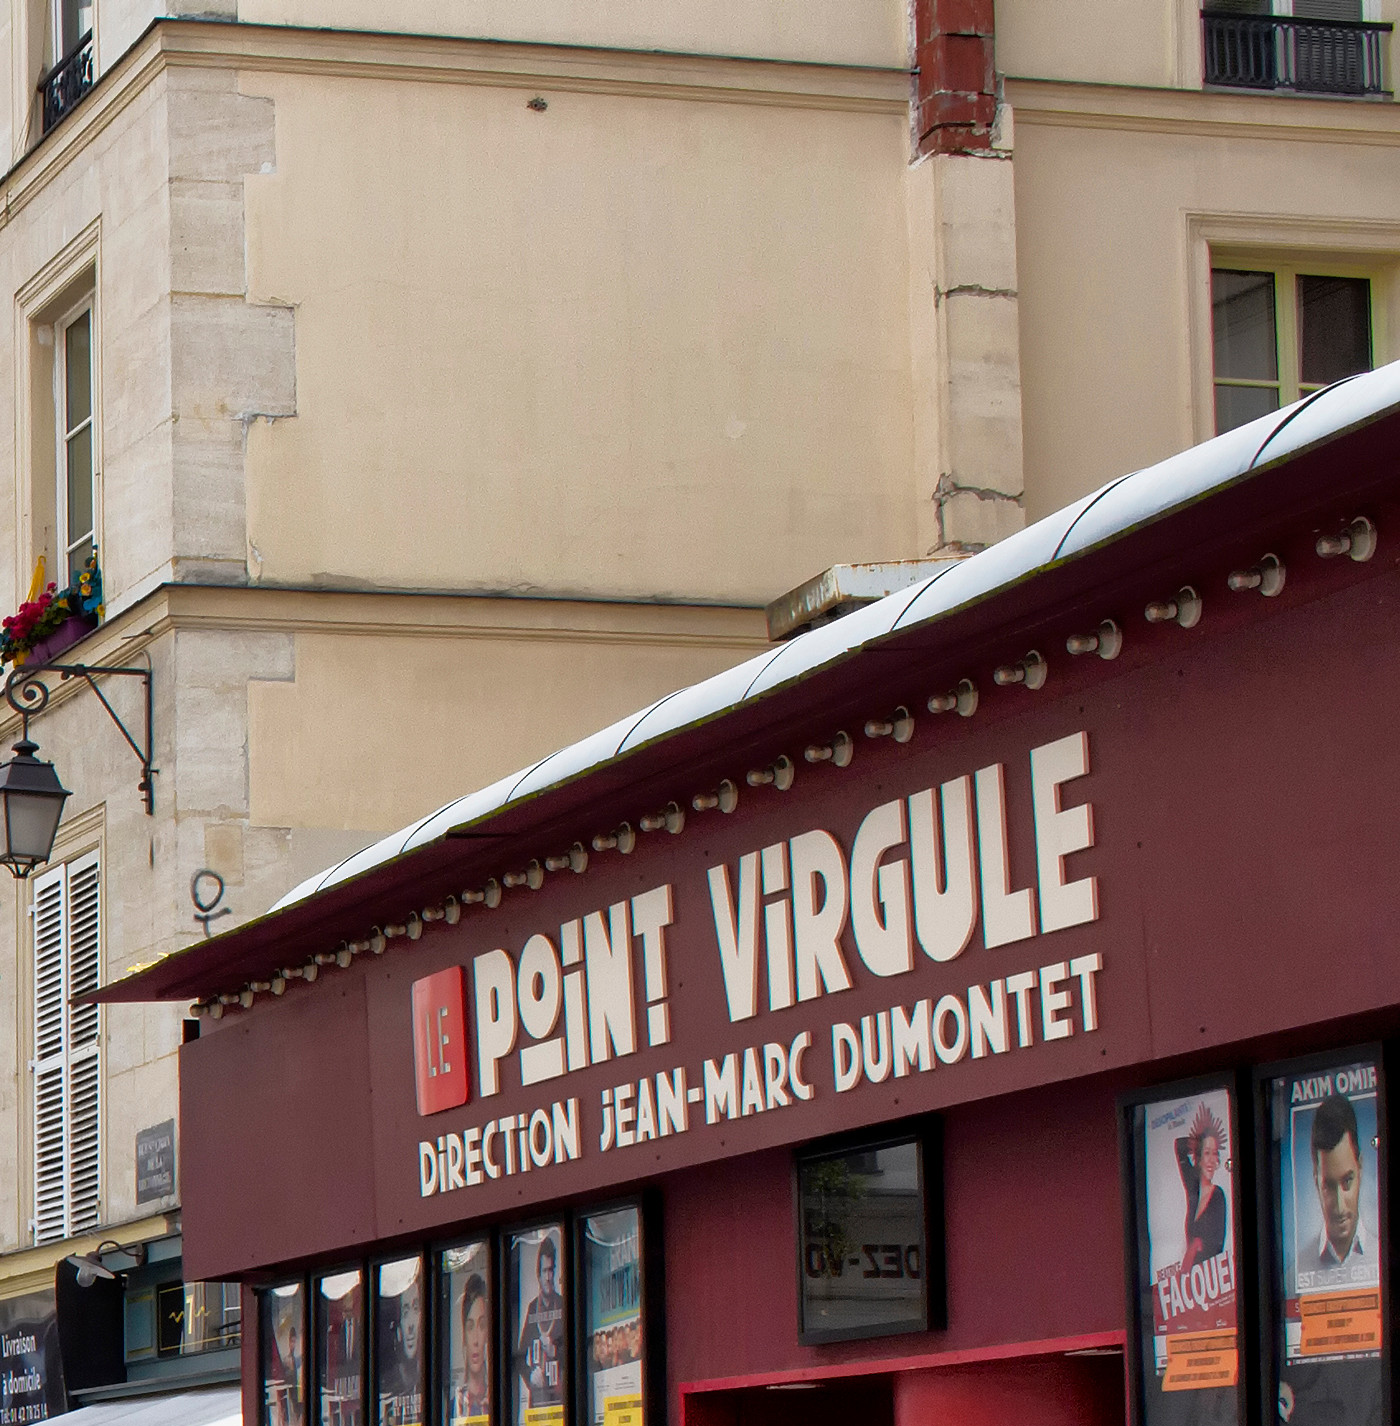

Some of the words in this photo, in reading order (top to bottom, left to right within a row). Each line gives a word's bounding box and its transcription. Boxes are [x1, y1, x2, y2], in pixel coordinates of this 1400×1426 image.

[832, 952, 1104, 1093] DUMONTET
[425, 1006, 451, 1079] LE
[1291, 1075, 1332, 1103] AKIM
[1, 1334, 36, 1358] Livraison
[8, 1366, 41, 1394] domicile
